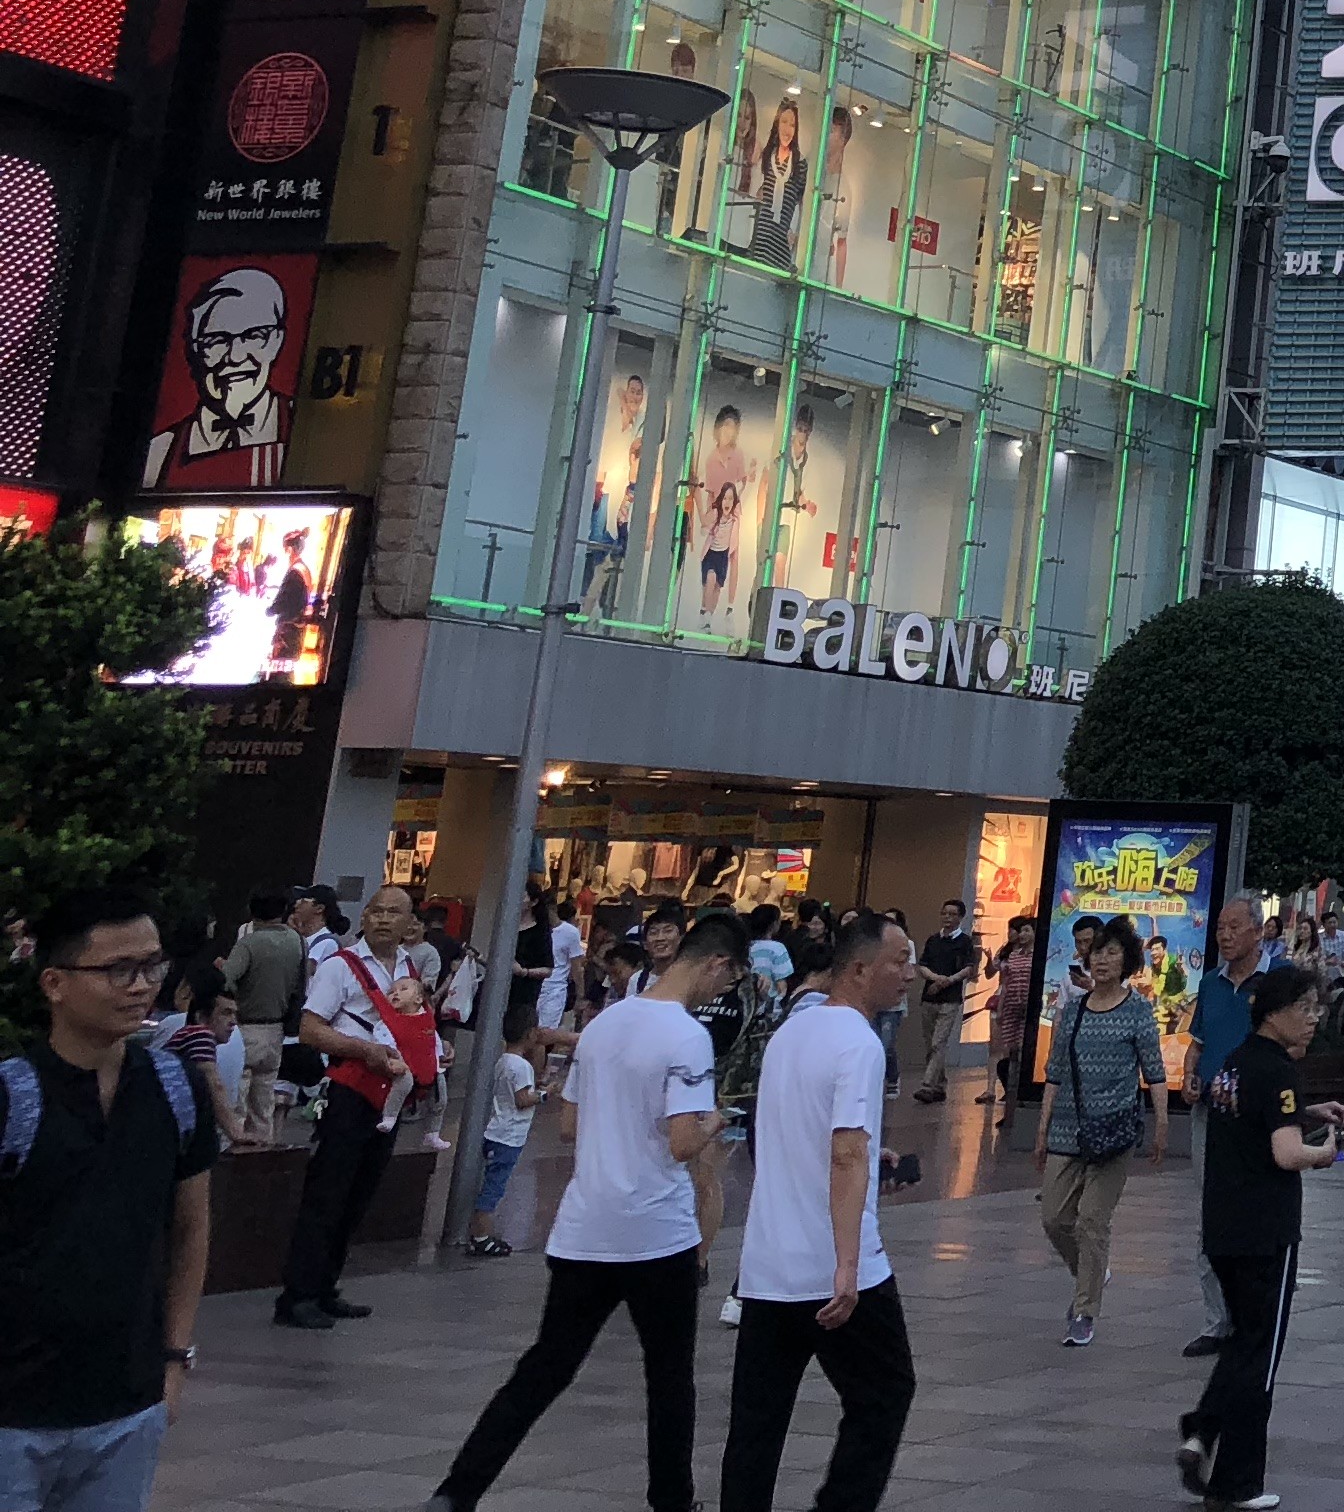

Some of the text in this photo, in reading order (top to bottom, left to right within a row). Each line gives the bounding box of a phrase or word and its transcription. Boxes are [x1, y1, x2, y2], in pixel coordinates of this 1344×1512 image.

[196, 205, 321, 221] New World Jewelers
[311, 345, 363, 400] B1
[205, 741, 304, 756] SOUVENIRS
[1280, 1089, 1296, 1115] 3
